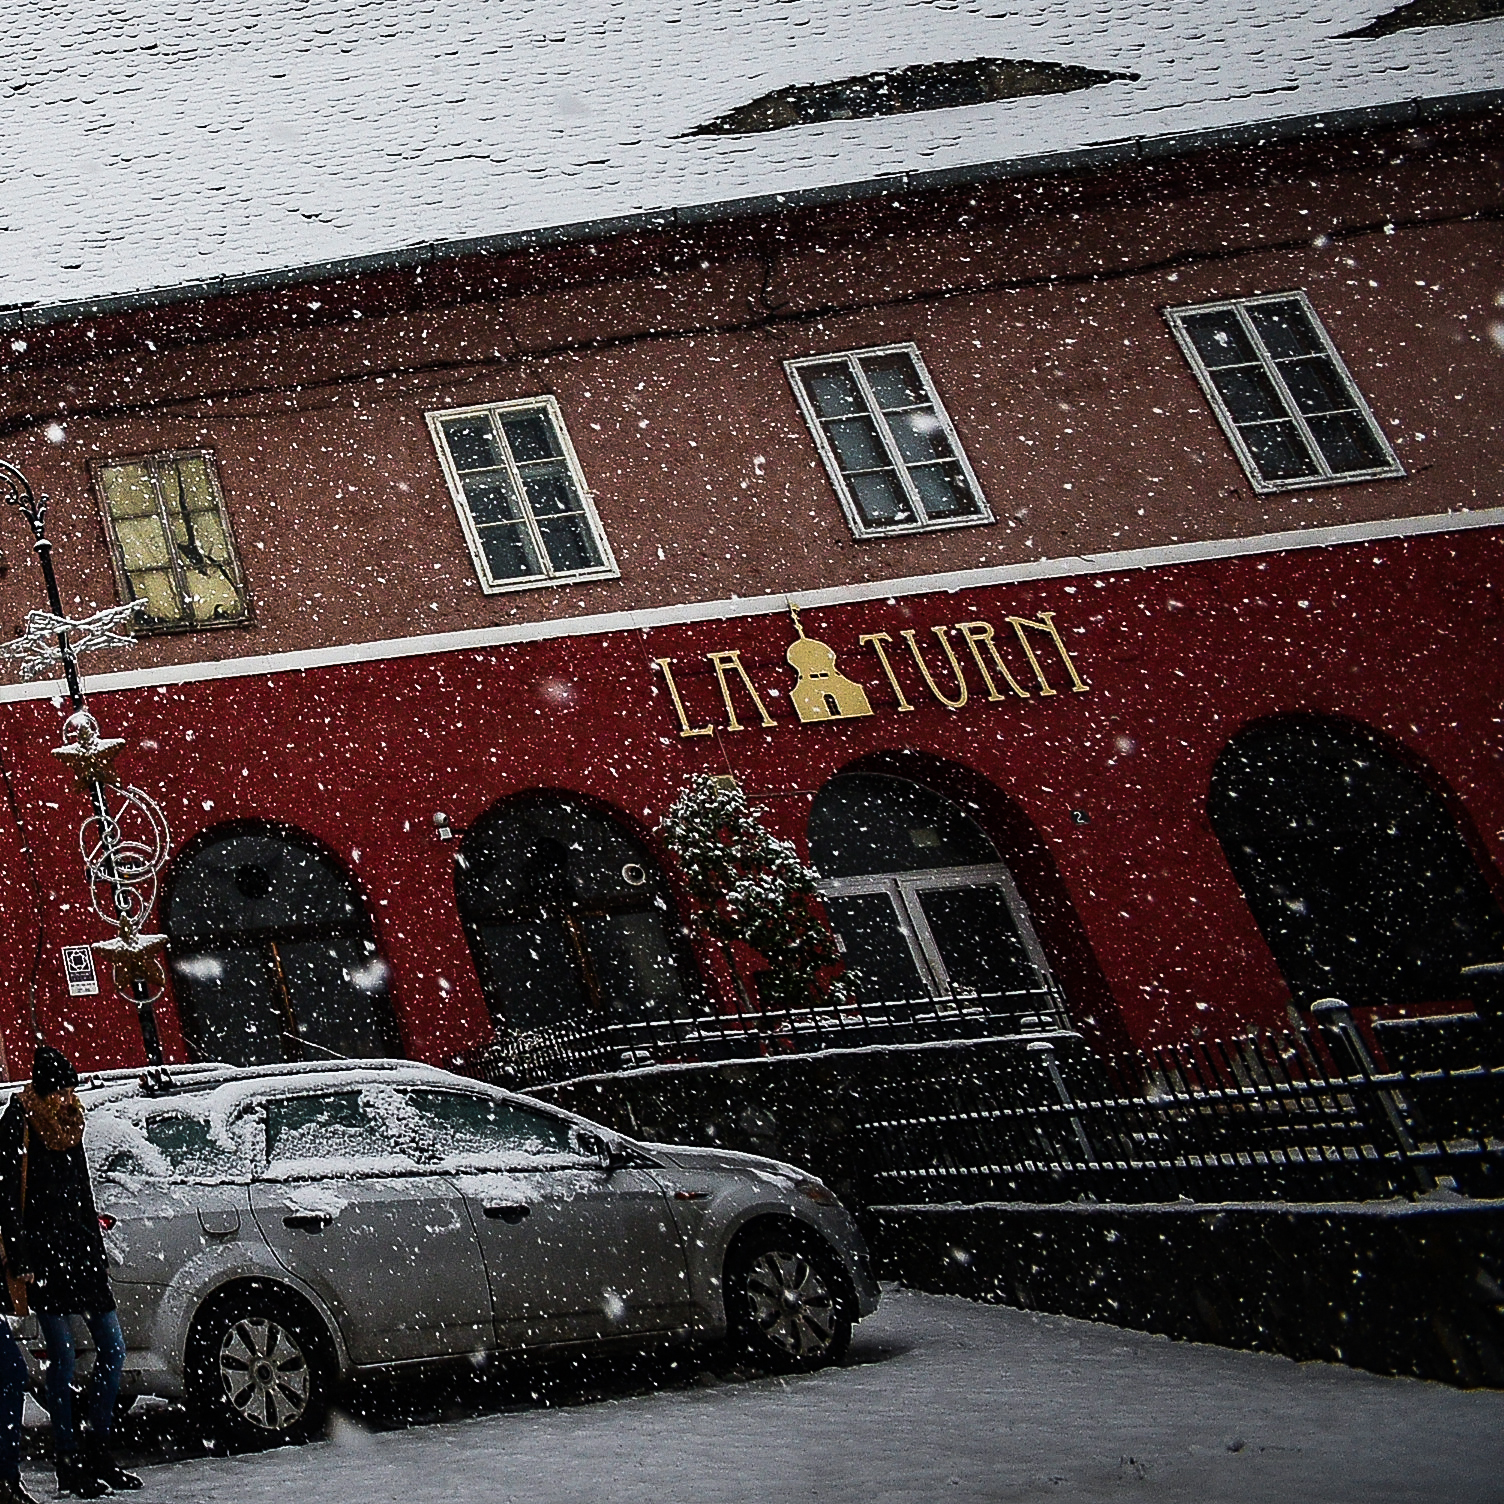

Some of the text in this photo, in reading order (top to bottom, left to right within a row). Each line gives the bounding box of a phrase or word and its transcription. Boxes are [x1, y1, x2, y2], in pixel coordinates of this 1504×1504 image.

[655, 612, 1090, 738] LA TURN
[1073, 811, 1085, 823] 2
